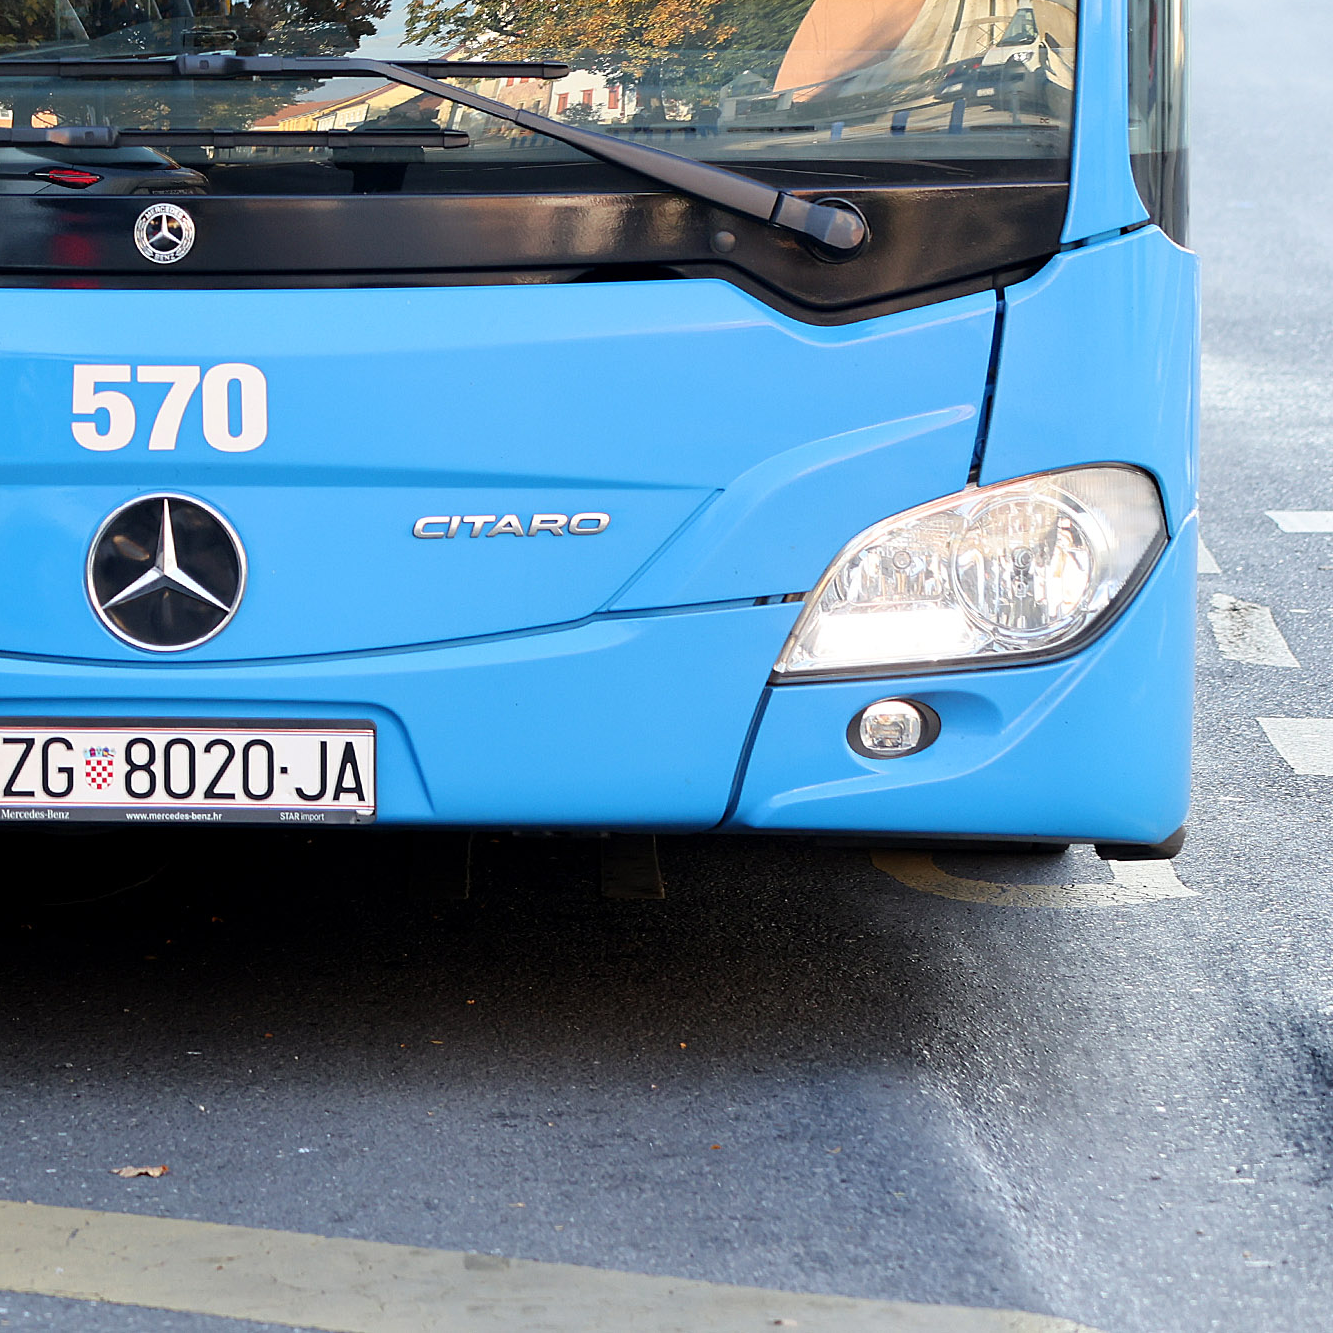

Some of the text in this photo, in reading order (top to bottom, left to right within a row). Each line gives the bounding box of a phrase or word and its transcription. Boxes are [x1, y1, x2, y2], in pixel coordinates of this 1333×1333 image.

[154, 252, 176, 261] BENZ
[72, 363, 267, 452] 570
[412, 511, 610, 539] CITARO
[2, 737, 74, 798] ZG
[1, 809, 69, 819] Mercedes-Benz
[126, 812, 222, 821] www.mercedes-benz.hr
[280, 812, 325, 822] STAR import
